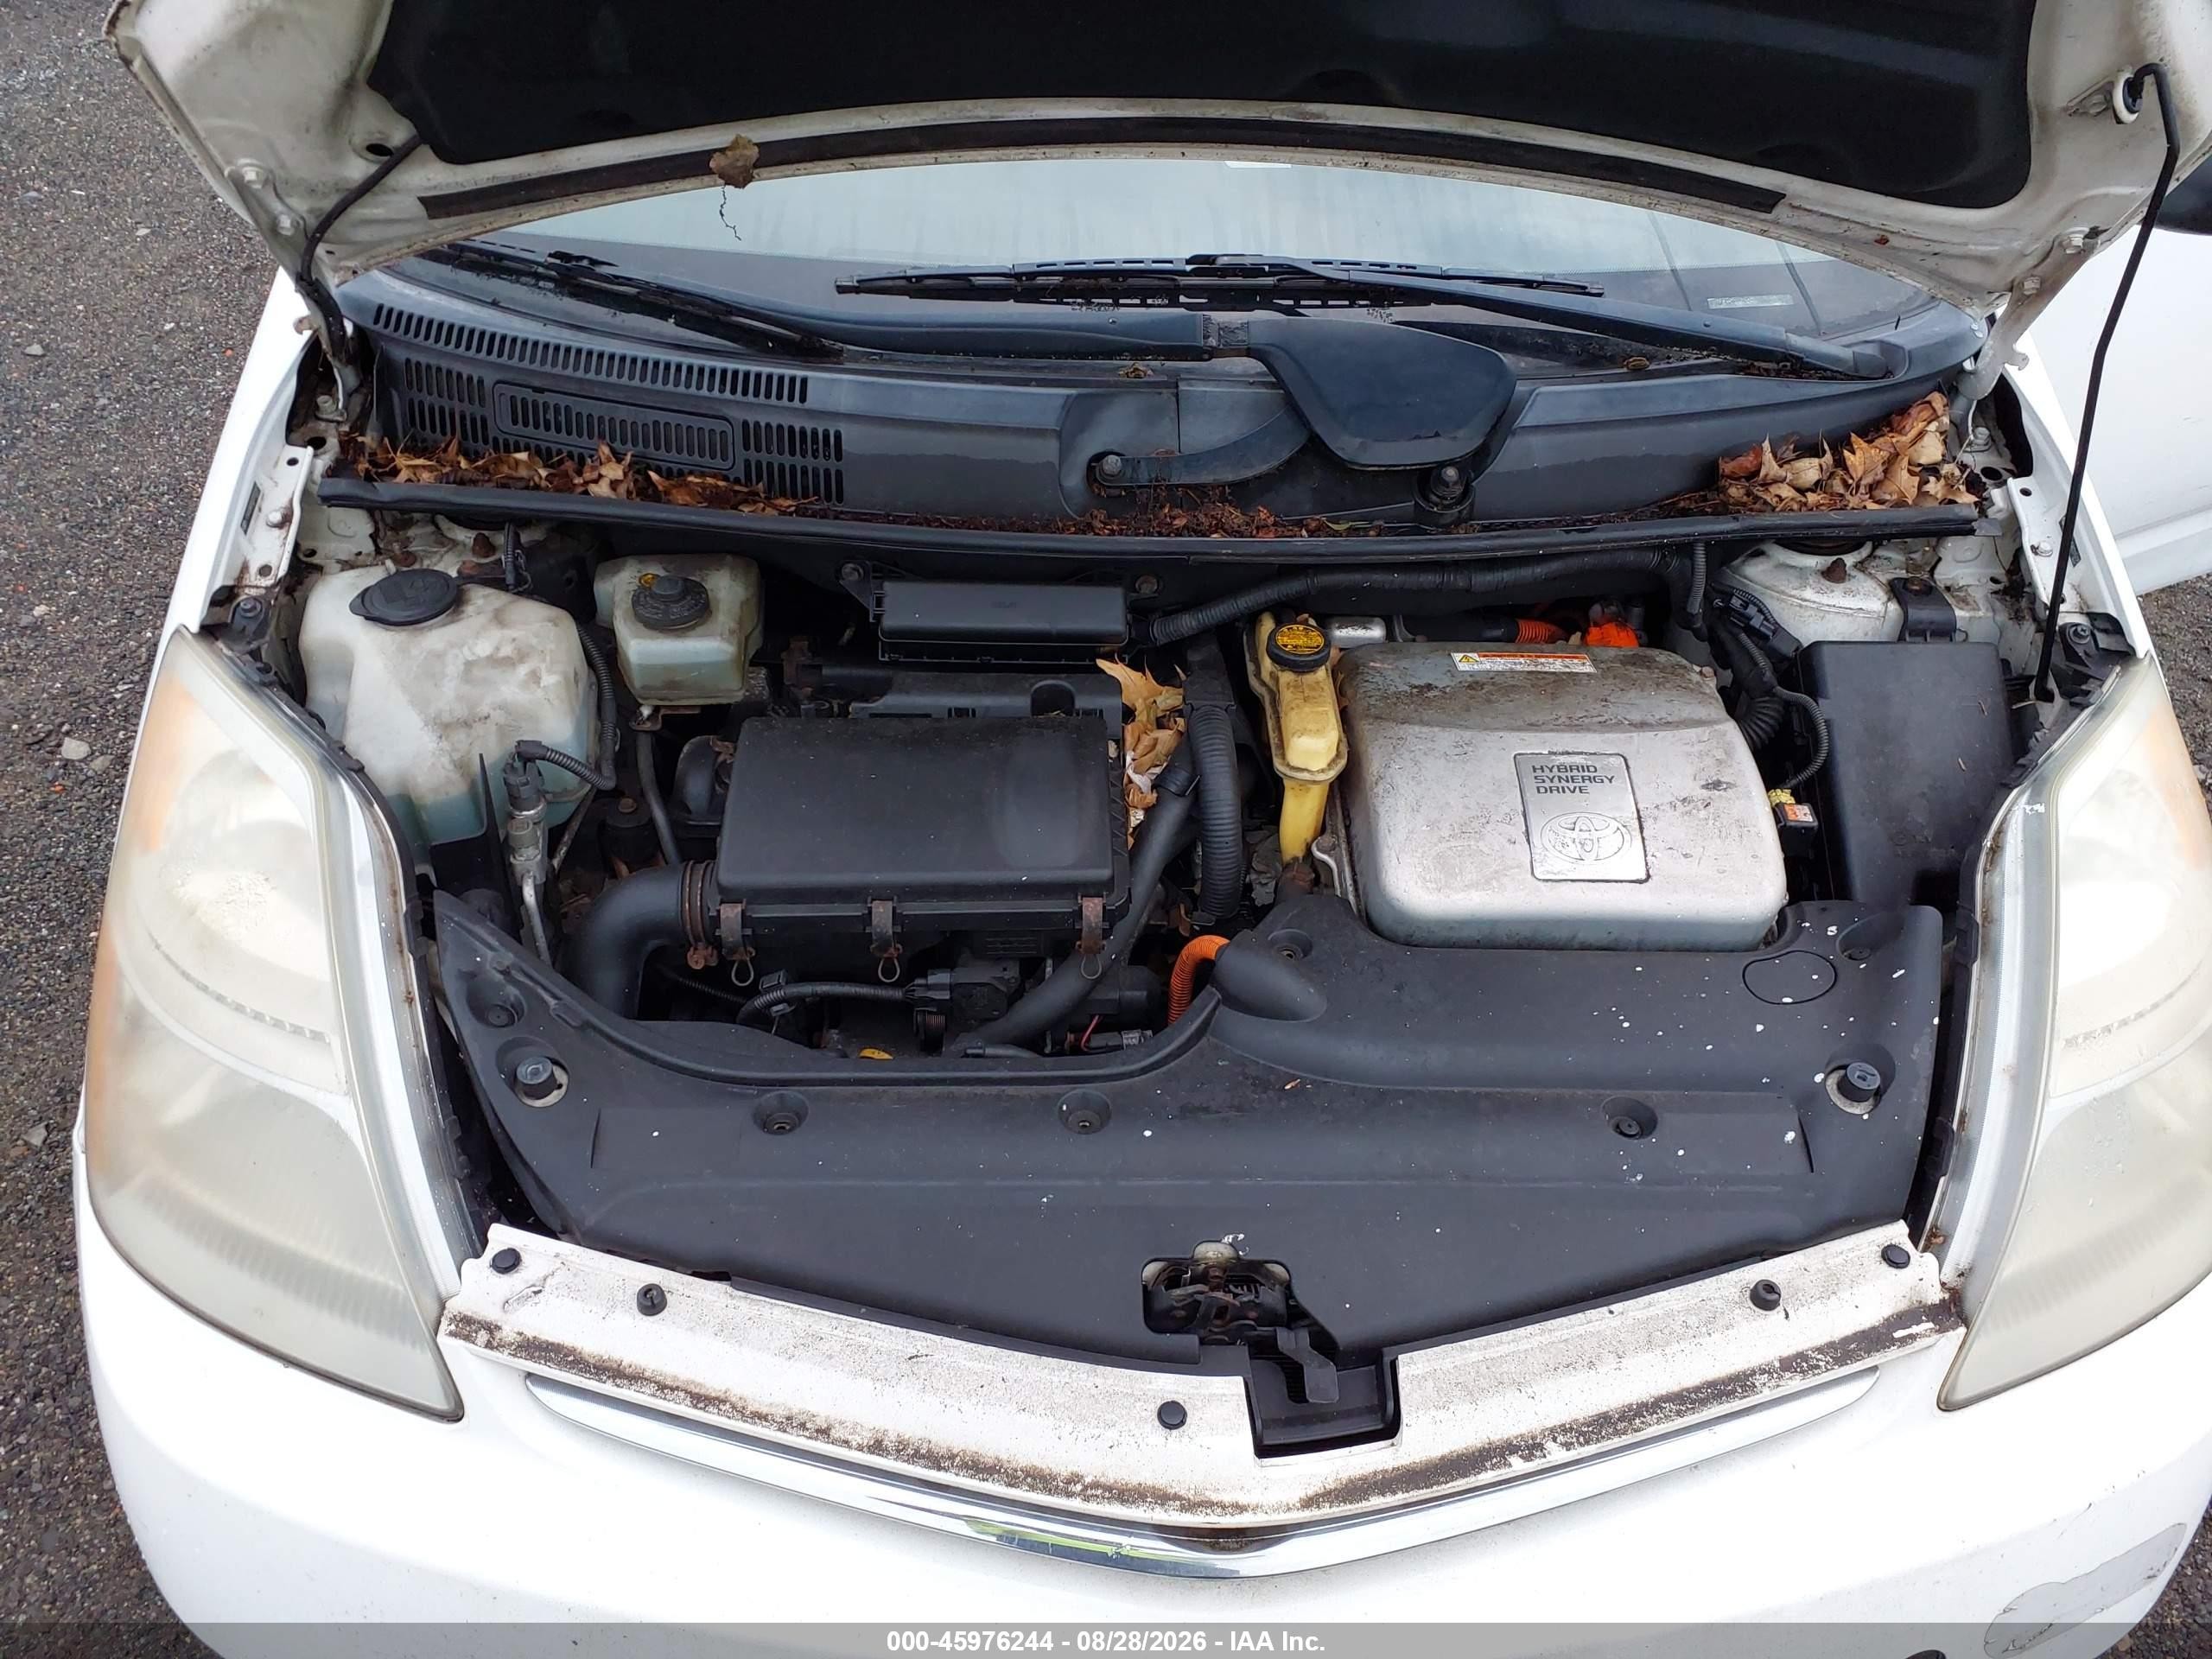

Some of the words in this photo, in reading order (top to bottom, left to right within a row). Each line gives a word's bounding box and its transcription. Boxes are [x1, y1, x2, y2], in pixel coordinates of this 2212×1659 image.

[1532, 765, 1598, 773] HYBRID
[1534, 775, 1615, 784] SYNERGY
[1536, 785, 1590, 794] DRIVE
